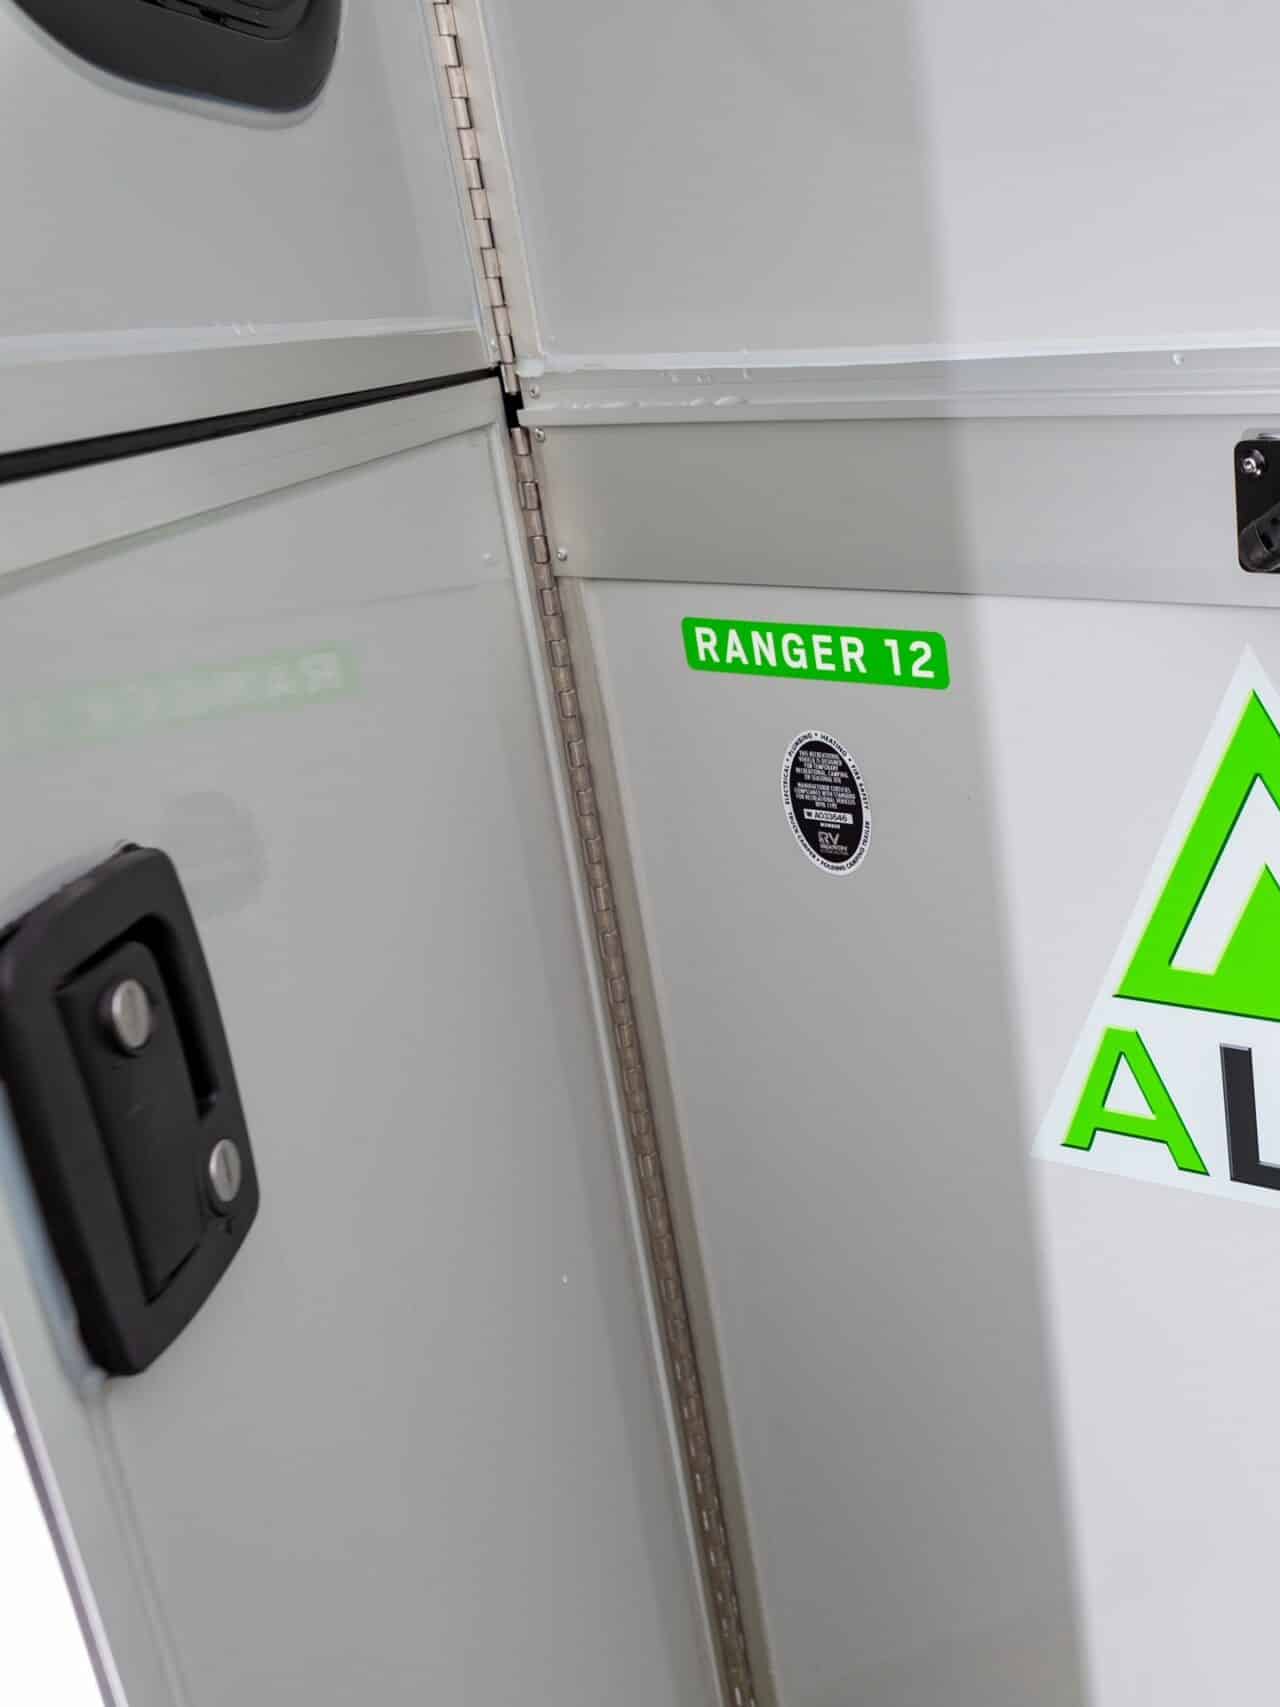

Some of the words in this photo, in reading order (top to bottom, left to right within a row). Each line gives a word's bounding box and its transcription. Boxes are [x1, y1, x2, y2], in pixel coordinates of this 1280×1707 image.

[694, 626, 867, 674] RANGER
[884, 638, 935, 679] 12
[818, 831, 840, 845] RV
